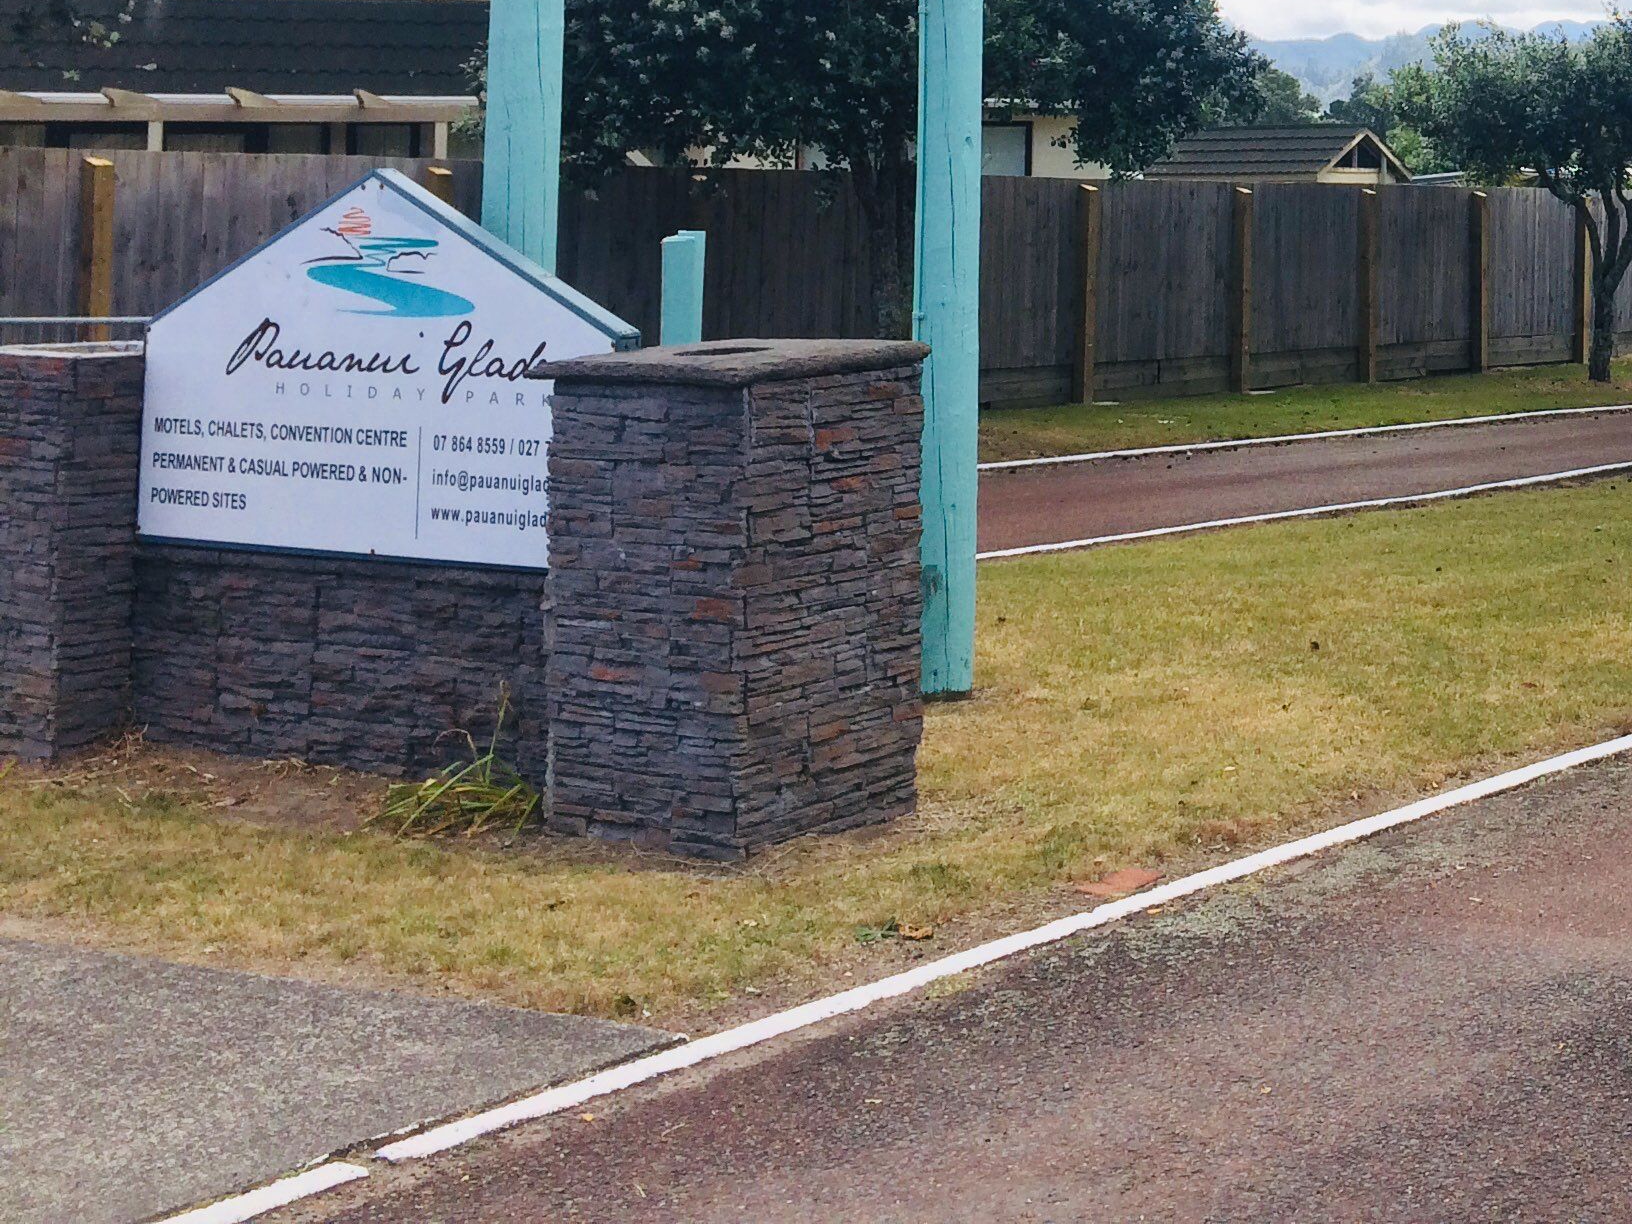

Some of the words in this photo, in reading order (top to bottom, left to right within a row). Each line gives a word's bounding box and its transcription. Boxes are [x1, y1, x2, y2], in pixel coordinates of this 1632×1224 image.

[225, 317, 424, 376] Pauanui
[437, 320, 548, 404] Glad
[275, 382, 426, 401] HOLIDAY
[465, 390, 551, 407] PARK
[154, 417, 205, 438] MOTELS,
[208, 420, 267, 442] CHALETS,
[270, 423, 353, 445] CONVENTION
[356, 429, 408, 448] CENTRE
[433, 434, 447, 451] 07
[451, 435, 472, 452] 864
[477, 436, 506, 455] 8559
[518, 439, 540, 457] 027
[152, 452, 225, 473] PERMANENT
[228, 457, 236, 474] &
[239, 457, 288, 477] CASUAL
[292, 461, 355, 482] POWERED
[358, 466, 367, 482] &
[372, 467, 408, 485] NON-
[151, 487, 209, 507] POWERED
[212, 492, 247, 510] SITES
